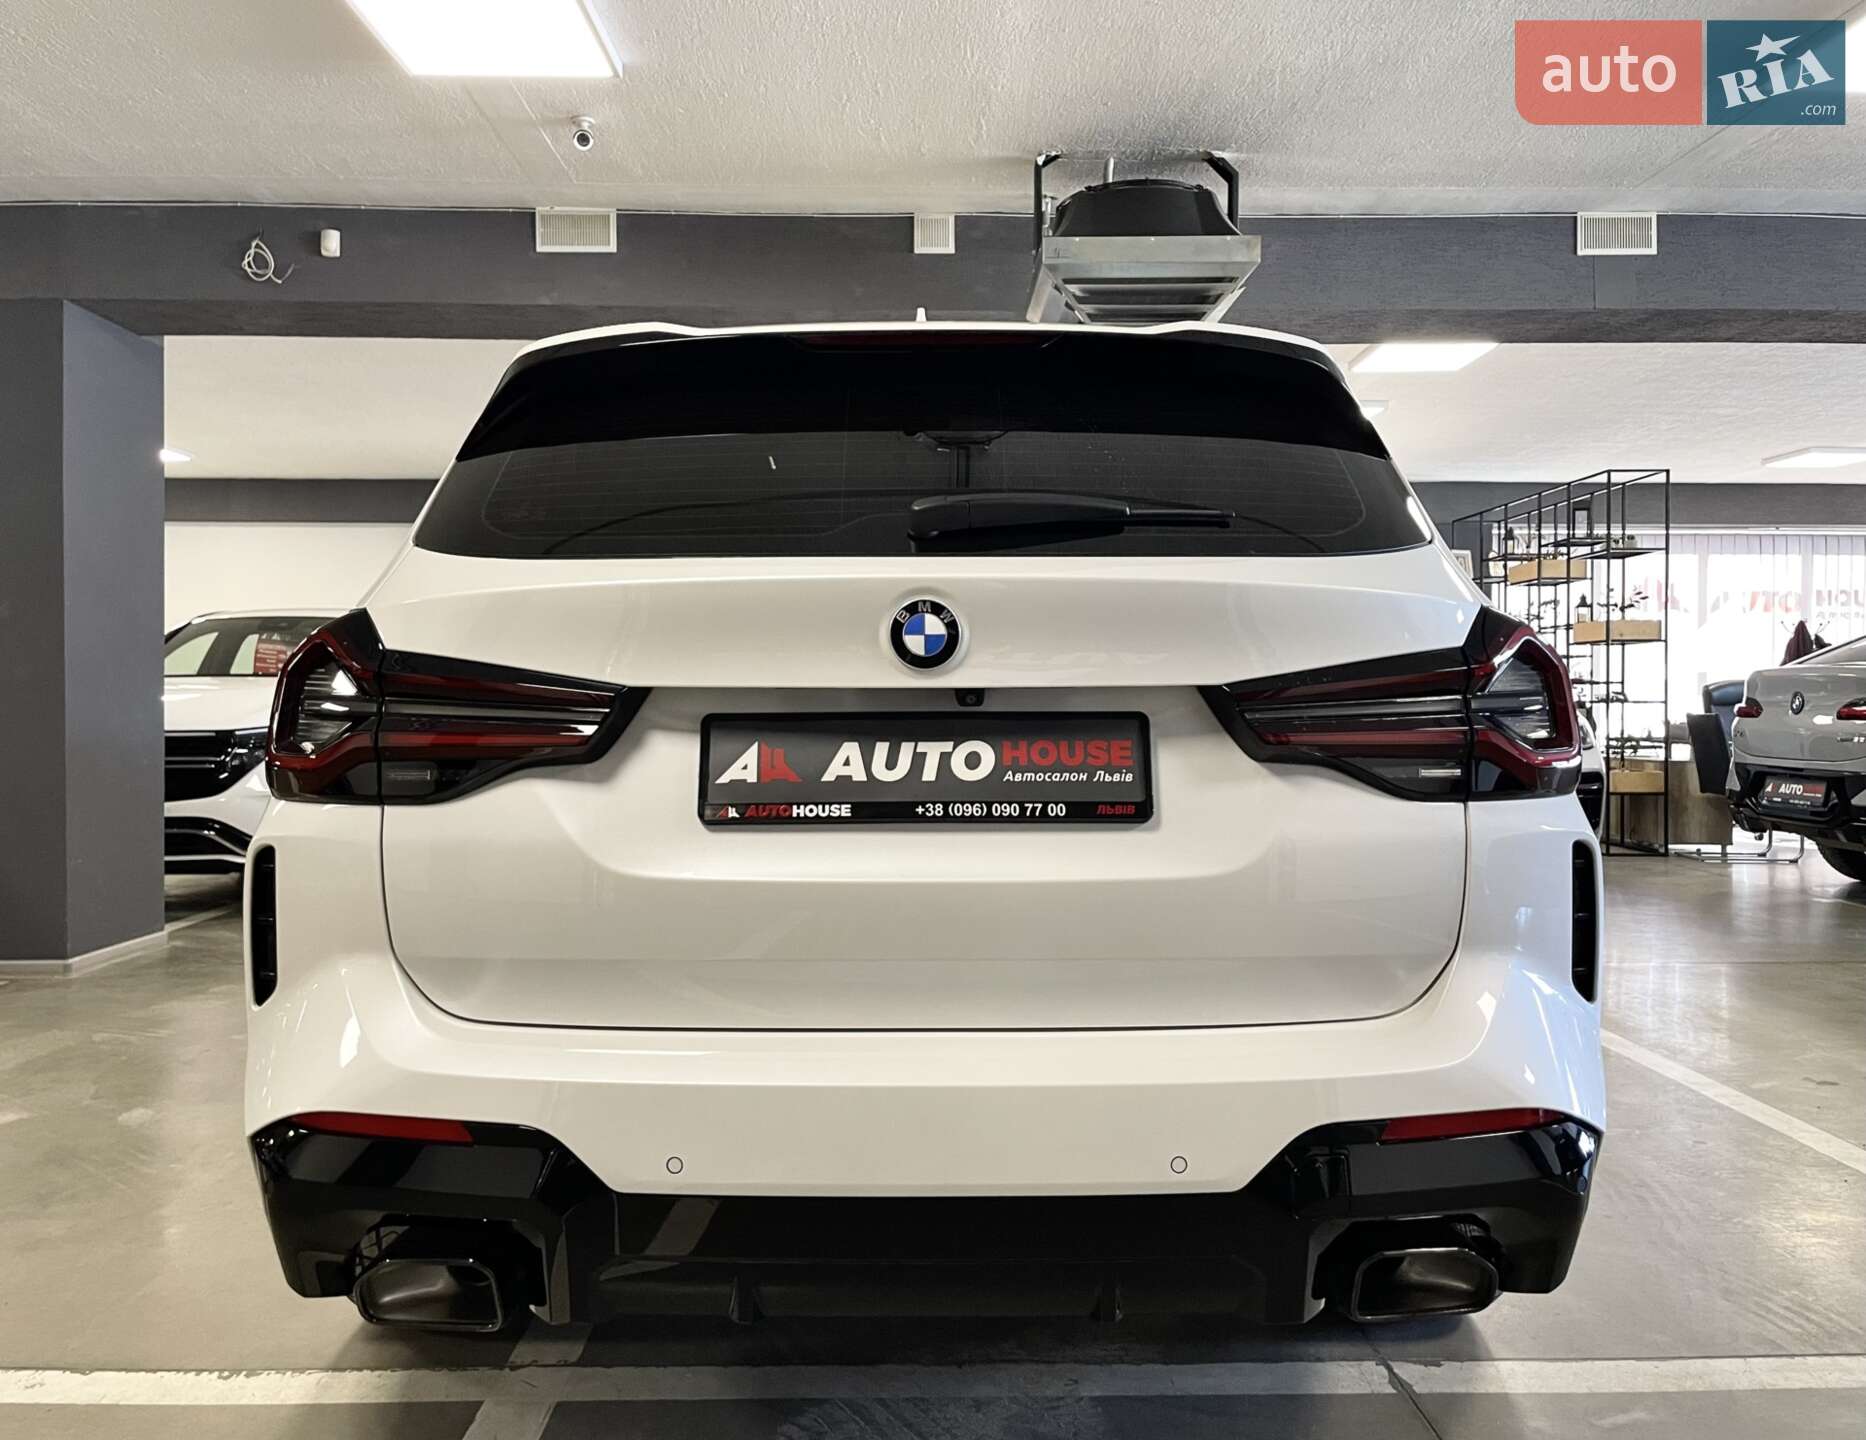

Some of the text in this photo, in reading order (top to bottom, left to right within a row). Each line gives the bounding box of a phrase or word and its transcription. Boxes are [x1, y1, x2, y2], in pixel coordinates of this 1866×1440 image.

[896, 601, 955, 623] BMW
[820, 740, 996, 782] AUTO
[1002, 740, 1135, 766] HOUSE
[1003, 769, 1134, 782] Автосалон Львів
[1778, 783, 1804, 795] AUTO
[915, 803, 944, 817] +38
[948, 803, 988, 817] (096)
[992, 803, 1020, 817] 090
[1024, 803, 1042, 816] 77
[1047, 803, 1067, 817] 00
